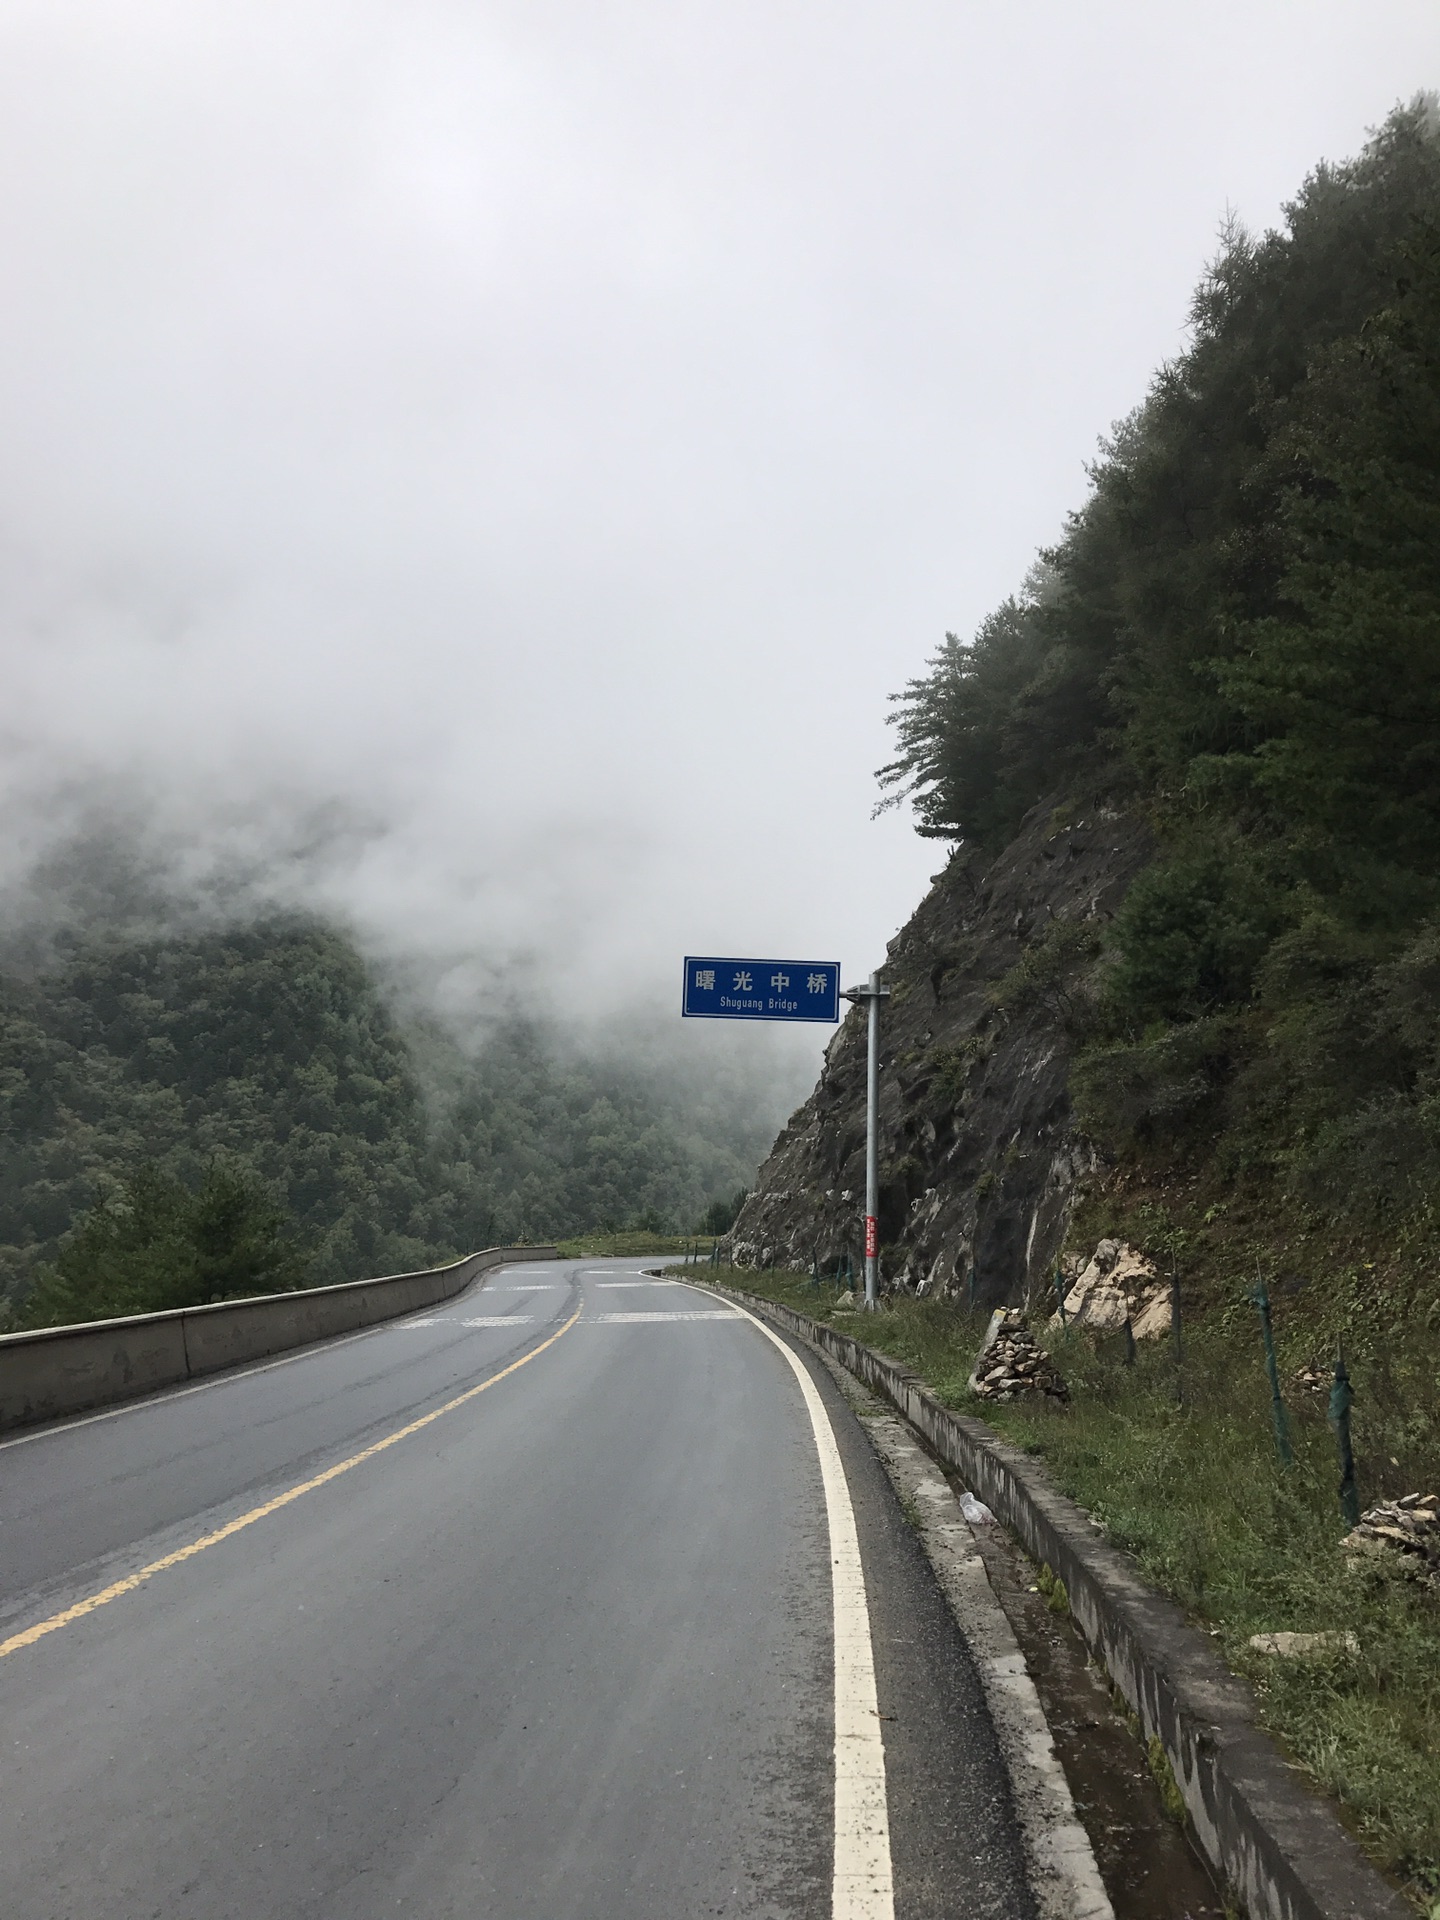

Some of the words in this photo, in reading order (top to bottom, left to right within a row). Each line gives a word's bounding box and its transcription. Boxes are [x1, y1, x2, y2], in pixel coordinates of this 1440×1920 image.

[695, 970, 828, 994] 曙光中桥
[720, 996, 763, 1011] Shuguang
[769, 998, 798, 1011] Bridge
